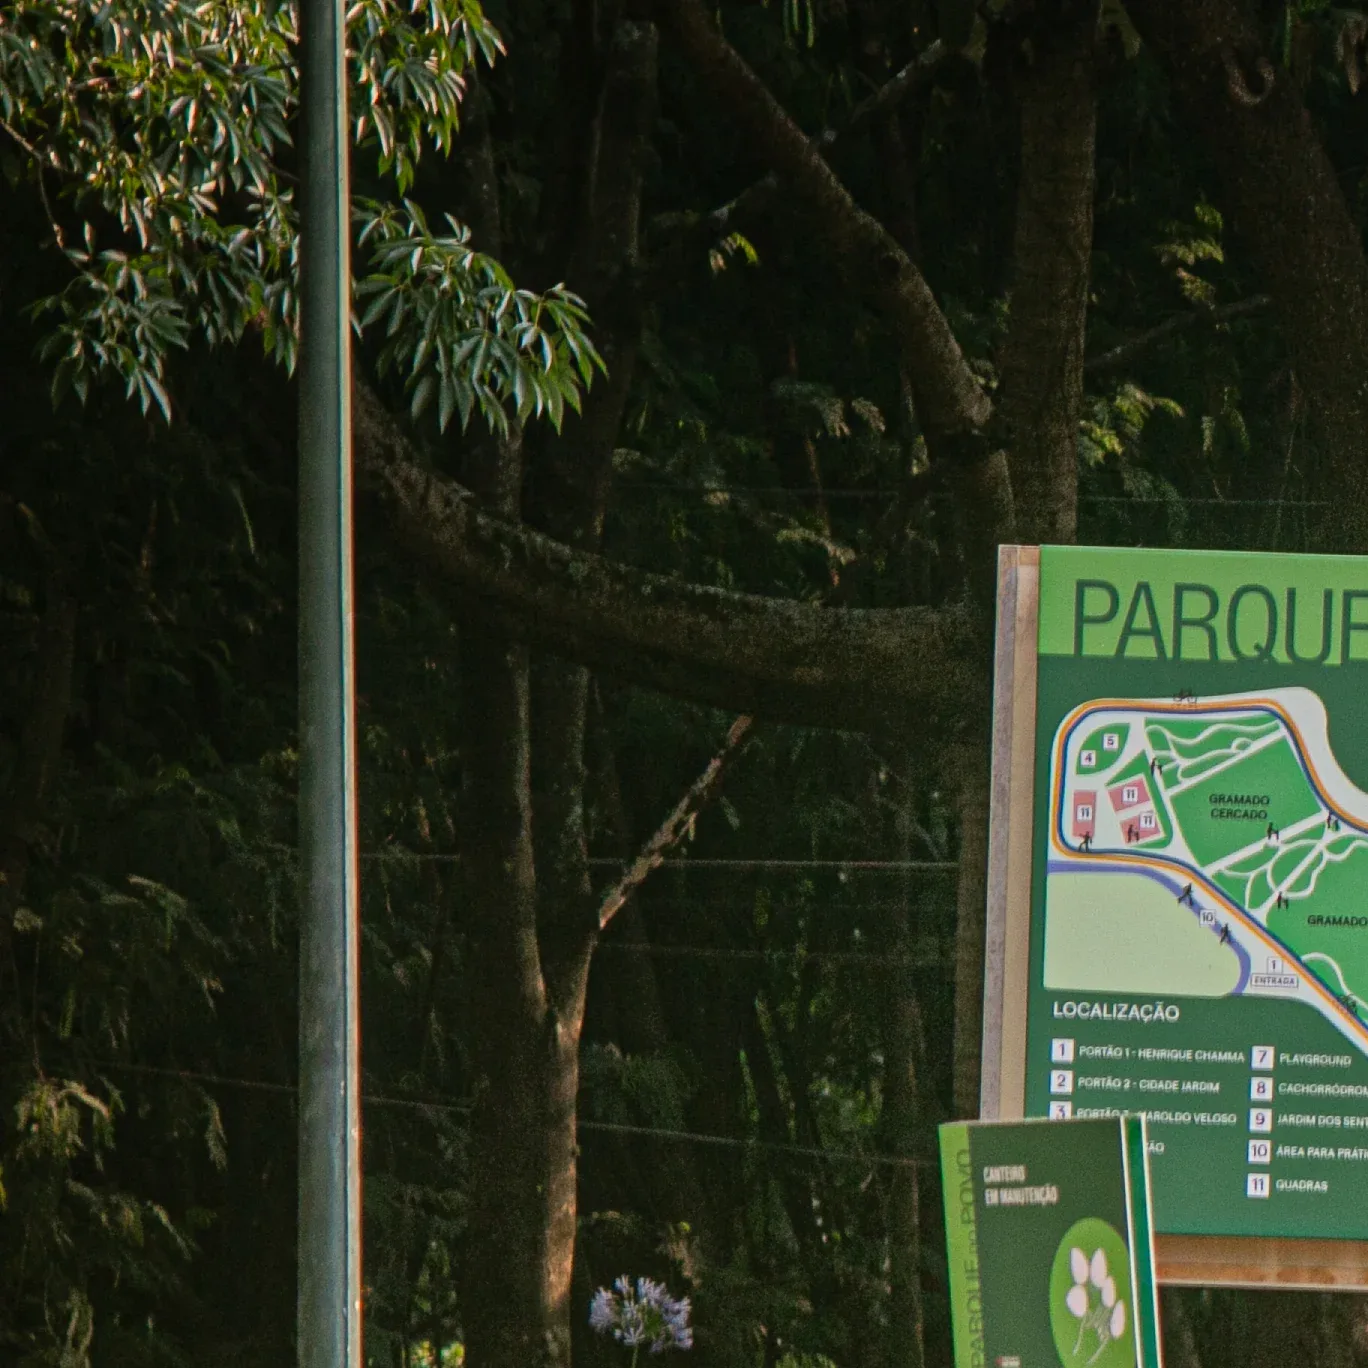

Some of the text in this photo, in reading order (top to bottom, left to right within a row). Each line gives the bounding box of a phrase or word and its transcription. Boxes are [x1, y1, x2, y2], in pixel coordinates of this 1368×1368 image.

[1107, 735, 1114, 746] 5
[1085, 752, 1092, 763] 4
[1126, 789, 1136, 799] 11
[1209, 793, 1270, 806] GRAMADO
[1081, 807, 1090, 818] 11
[1210, 808, 1268, 820] CERCADO
[1202, 912, 1214, 923] 10
[1307, 914, 1368, 927] GRAMADO
[1254, 976, 1295, 986] ENTRADA
[1053, 1001, 1180, 1024] LOCALIZAÇÃO
[1079, 1044, 1122, 1058] PORTÃO
[1138, 1048, 1193, 1061] HENRIQUE
[1195, 1050, 1245, 1063] CHAMMA
[1258, 1051, 1352, 1067] 7 PLAYGROUND
[1057, 1074, 1066, 1087] 2
[1077, 1075, 1121, 1089] PORTÃO
[1123, 1079, 1130, 1089] 2
[1139, 1079, 1179, 1091] CIDADE
[1181, 1081, 1220, 1094] JARDIM
[1257, 1081, 1265, 1094] 8
[1193, 1112, 1237, 1125] VELOSO
[1255, 1112, 1264, 1125] 9
[1278, 1114, 1315, 1126] JARDIM
[1318, 1115, 1341, 1127] DOS
[1251, 1143, 1267, 1157] 10
[1276, 1145, 1304, 1157] ÁREA
[1307, 1146, 1335, 1159] PARA
[1252, 1177, 1328, 1192] 11 QUADRAS
